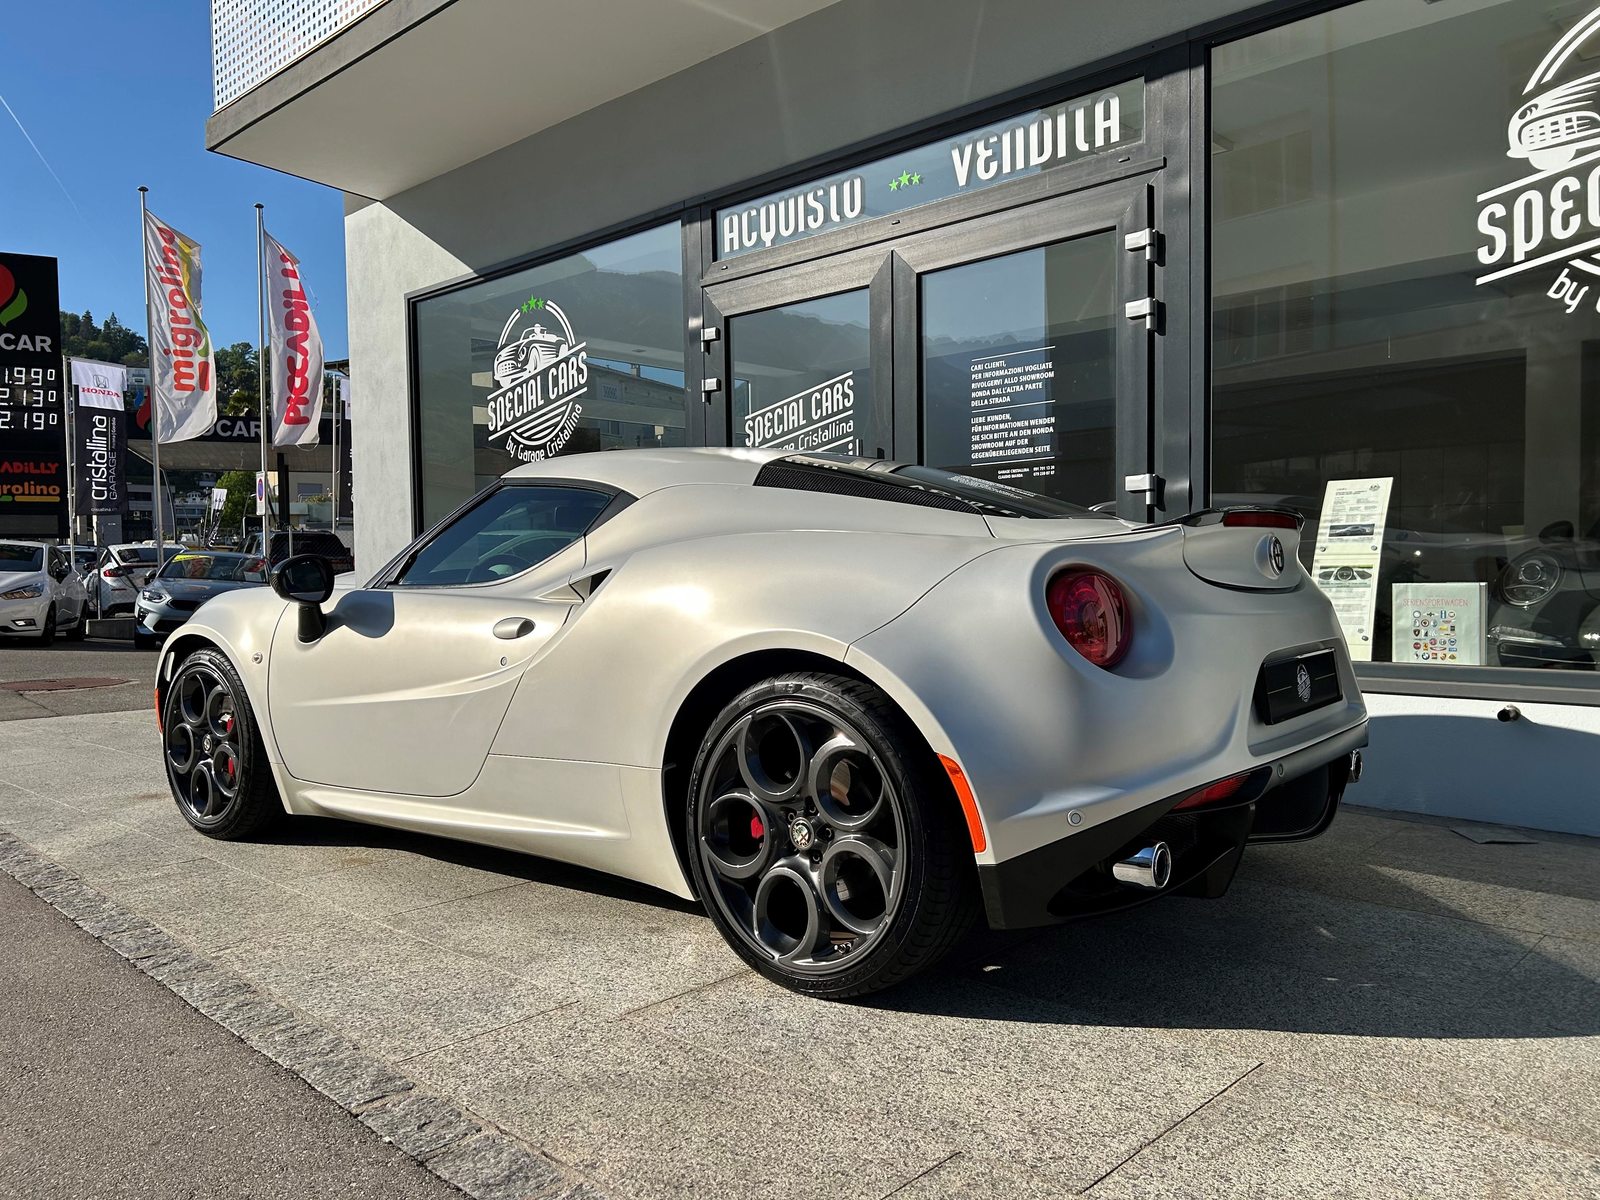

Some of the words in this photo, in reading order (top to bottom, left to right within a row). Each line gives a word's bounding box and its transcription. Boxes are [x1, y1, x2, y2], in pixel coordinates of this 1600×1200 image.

[723, 177, 863, 253] ACQUISTO
[951, 94, 1120, 188] VENDITA
[1547, 268, 1589, 313] by
[157, 226, 201, 391] migrolino
[983, 366, 1024, 378] INFORMAZIONI
[1025, 362, 1053, 372] VOGLIATE
[985, 361, 1006, 369] CLIENTI,
[971, 379, 1003, 389] RIVOLGERVI
[1019, 371, 1055, 382] SHOWROOM
[81, 387, 120, 398] HONDA
[487, 376, 544, 432] SPECIAL
[548, 351, 588, 400] CARS
[971, 389, 991, 398] HONDA
[991, 385, 1024, 395] DALL'ALTRA
[1025, 382, 1043, 391] PARTE
[971, 399, 988, 407] DELLA
[989, 396, 1011, 405] STRADA
[745, 398, 806, 447] SPECIAL
[811, 378, 854, 420] CARS
[987, 413, 1012, 422] KUNDEN,
[506, 436, 516, 458] by
[518, 444, 545, 462] Garage
[546, 404, 582, 457] Cristallina
[971, 424, 982, 433] FÜR
[982, 420, 1029, 432] INFORMATIONEN
[1029, 417, 1055, 426] WENDEN
[980, 433, 993, 441] SICH
[994, 431, 1008, 439] BITTE
[1032, 426, 1054, 435] HONDA
[798, 420, 854, 451] Cristallina
[971, 441, 1004, 451] SHOWROOM
[1017, 438, 1029, 446] DER
[971, 447, 1033, 459] GEGENÜBERLIEGENDEN
[1034, 445, 1051, 453] SEITE
[86, 415, 107, 501] cristallina
[109, 452, 118, 500] GARAGE
